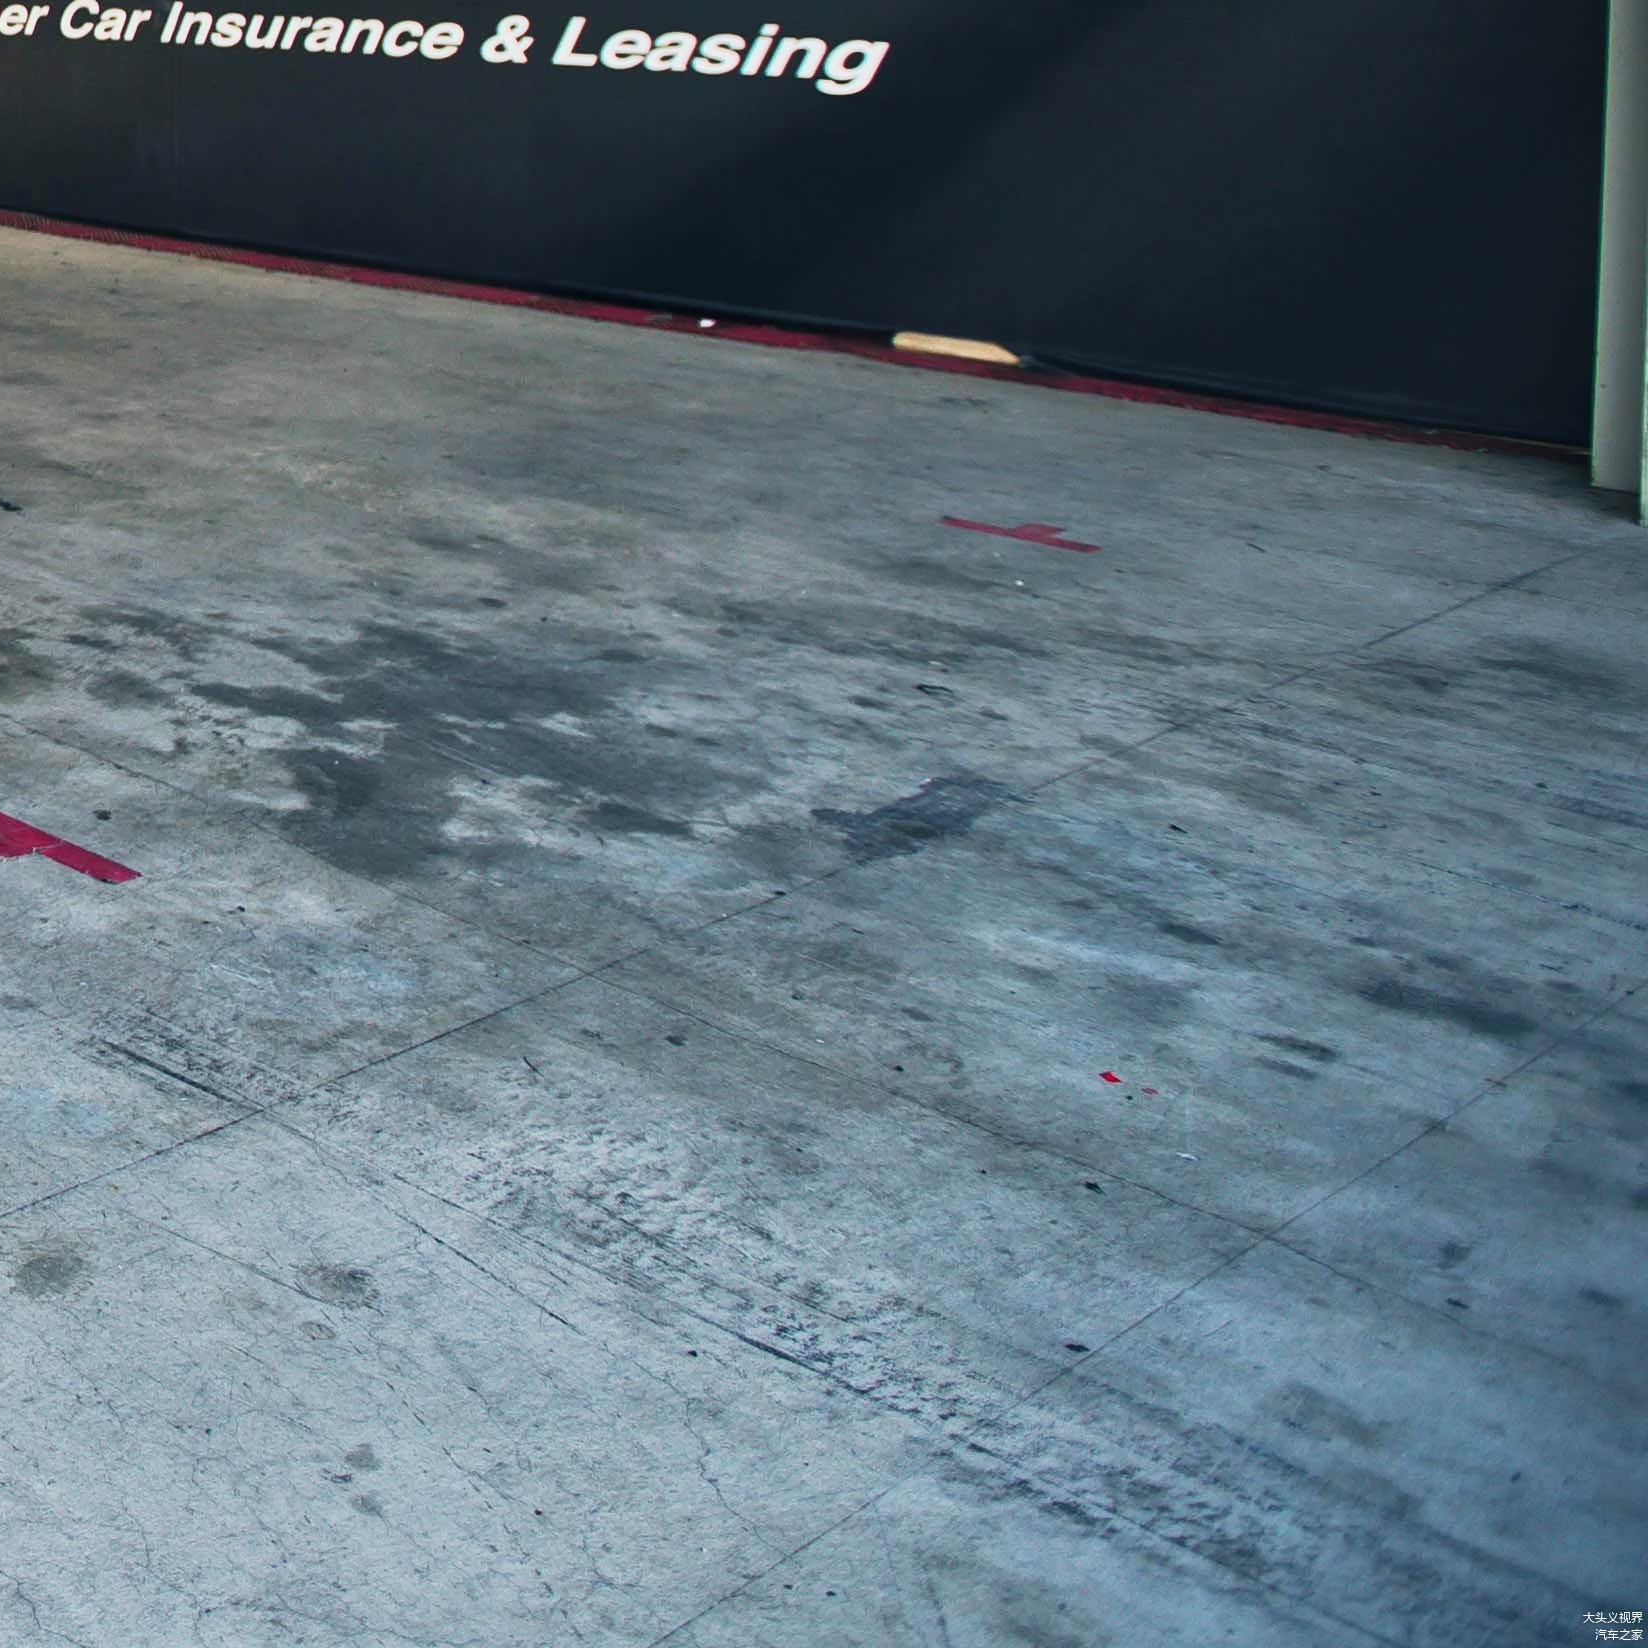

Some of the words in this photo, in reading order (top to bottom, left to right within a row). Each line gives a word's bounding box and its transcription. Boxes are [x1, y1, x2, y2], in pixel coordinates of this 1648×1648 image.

[160, 0, 465, 60] Insurance
[480, 14, 534, 64] &
[552, 16, 891, 96] Leasing
